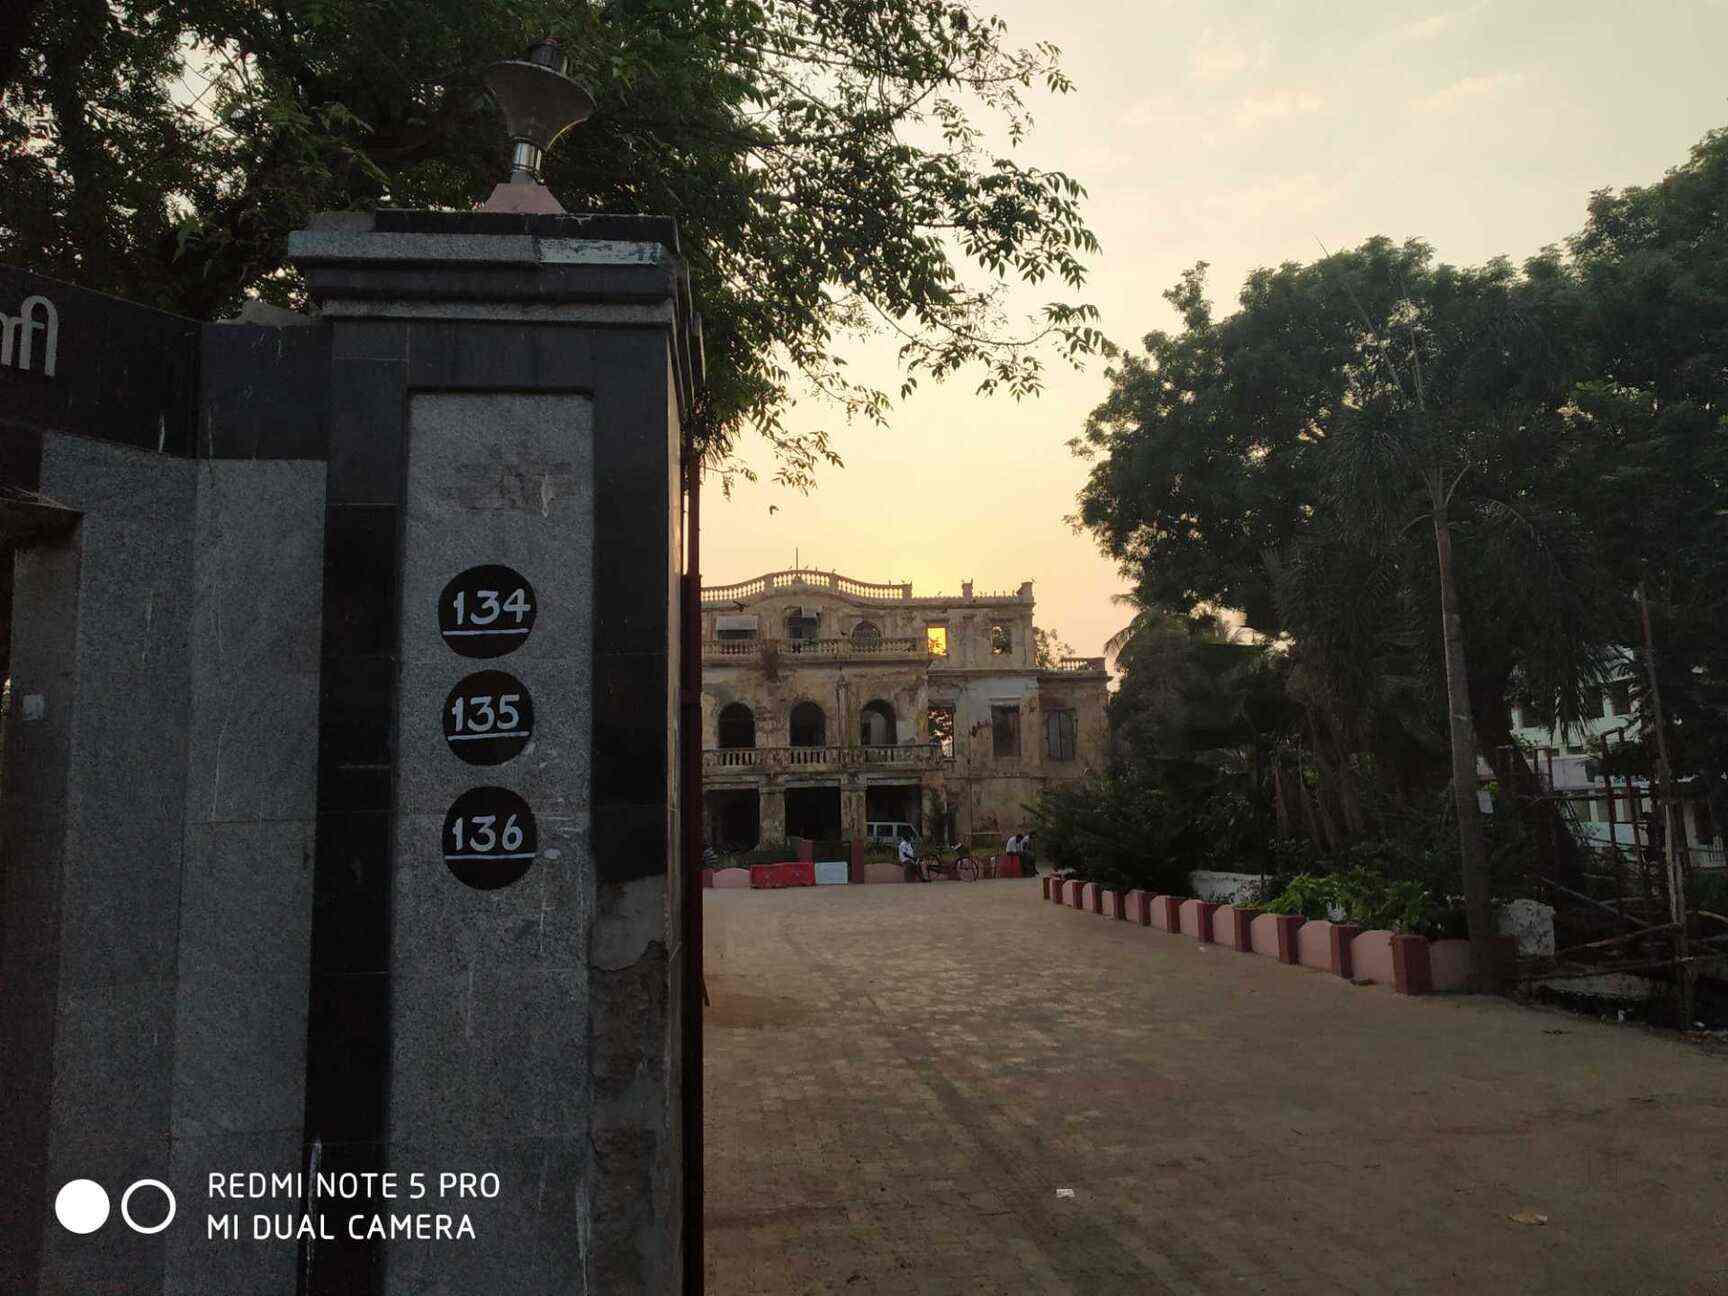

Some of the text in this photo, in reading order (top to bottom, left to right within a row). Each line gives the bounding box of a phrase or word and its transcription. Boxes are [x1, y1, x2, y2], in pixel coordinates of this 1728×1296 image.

[453, 588, 531, 626] 134
[451, 694, 520, 733] 135
[452, 814, 524, 852] 136
